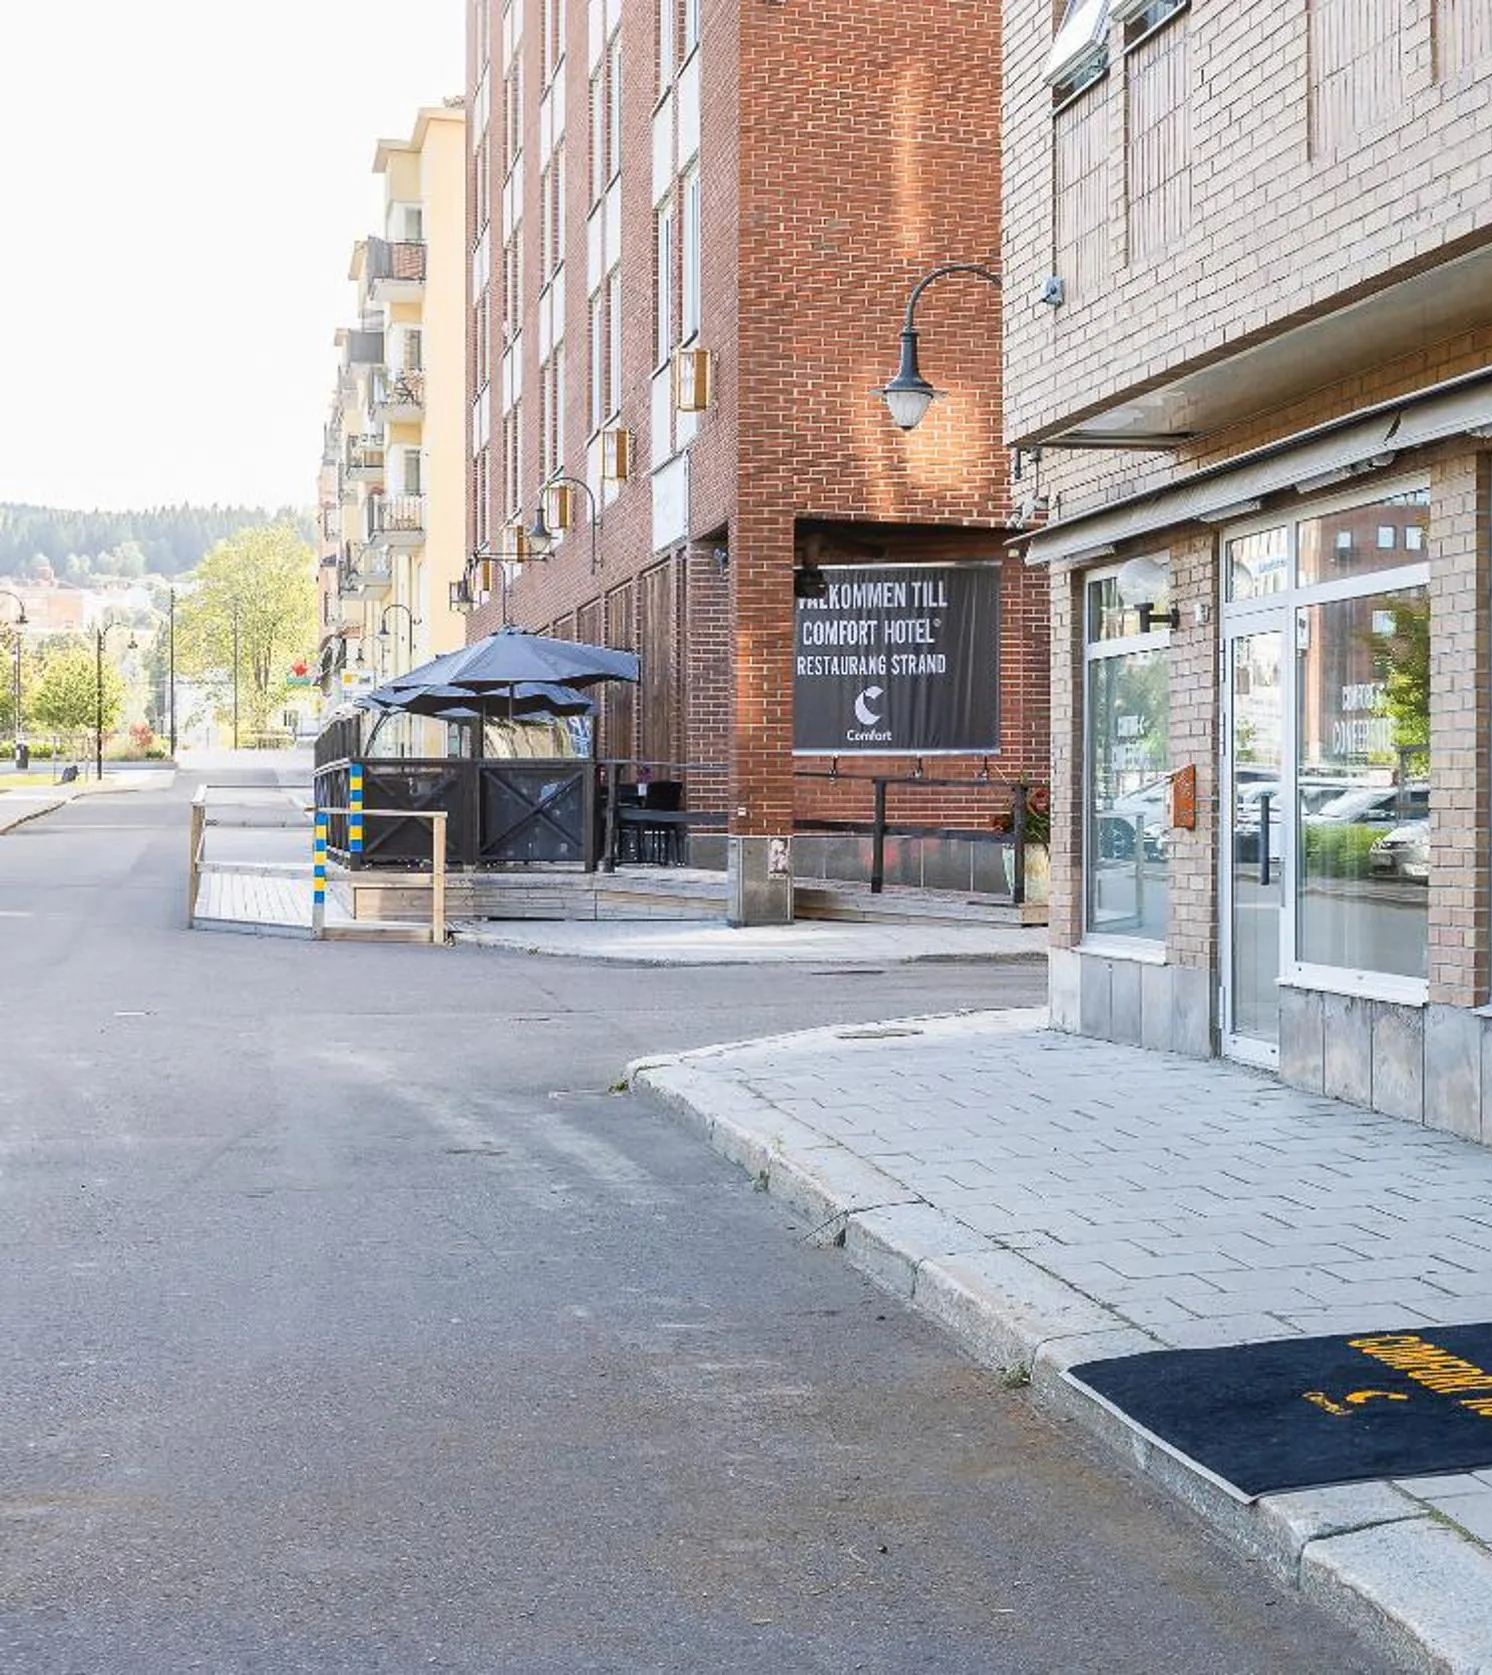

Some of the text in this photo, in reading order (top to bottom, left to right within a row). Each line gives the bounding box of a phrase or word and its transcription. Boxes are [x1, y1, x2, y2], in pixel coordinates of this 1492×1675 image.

[911, 581, 948, 608] TILL
[803, 620, 878, 646] COMFORT
[797, 654, 947, 676] RESTAURANG STRAND
[846, 729, 892, 742] Comfort
